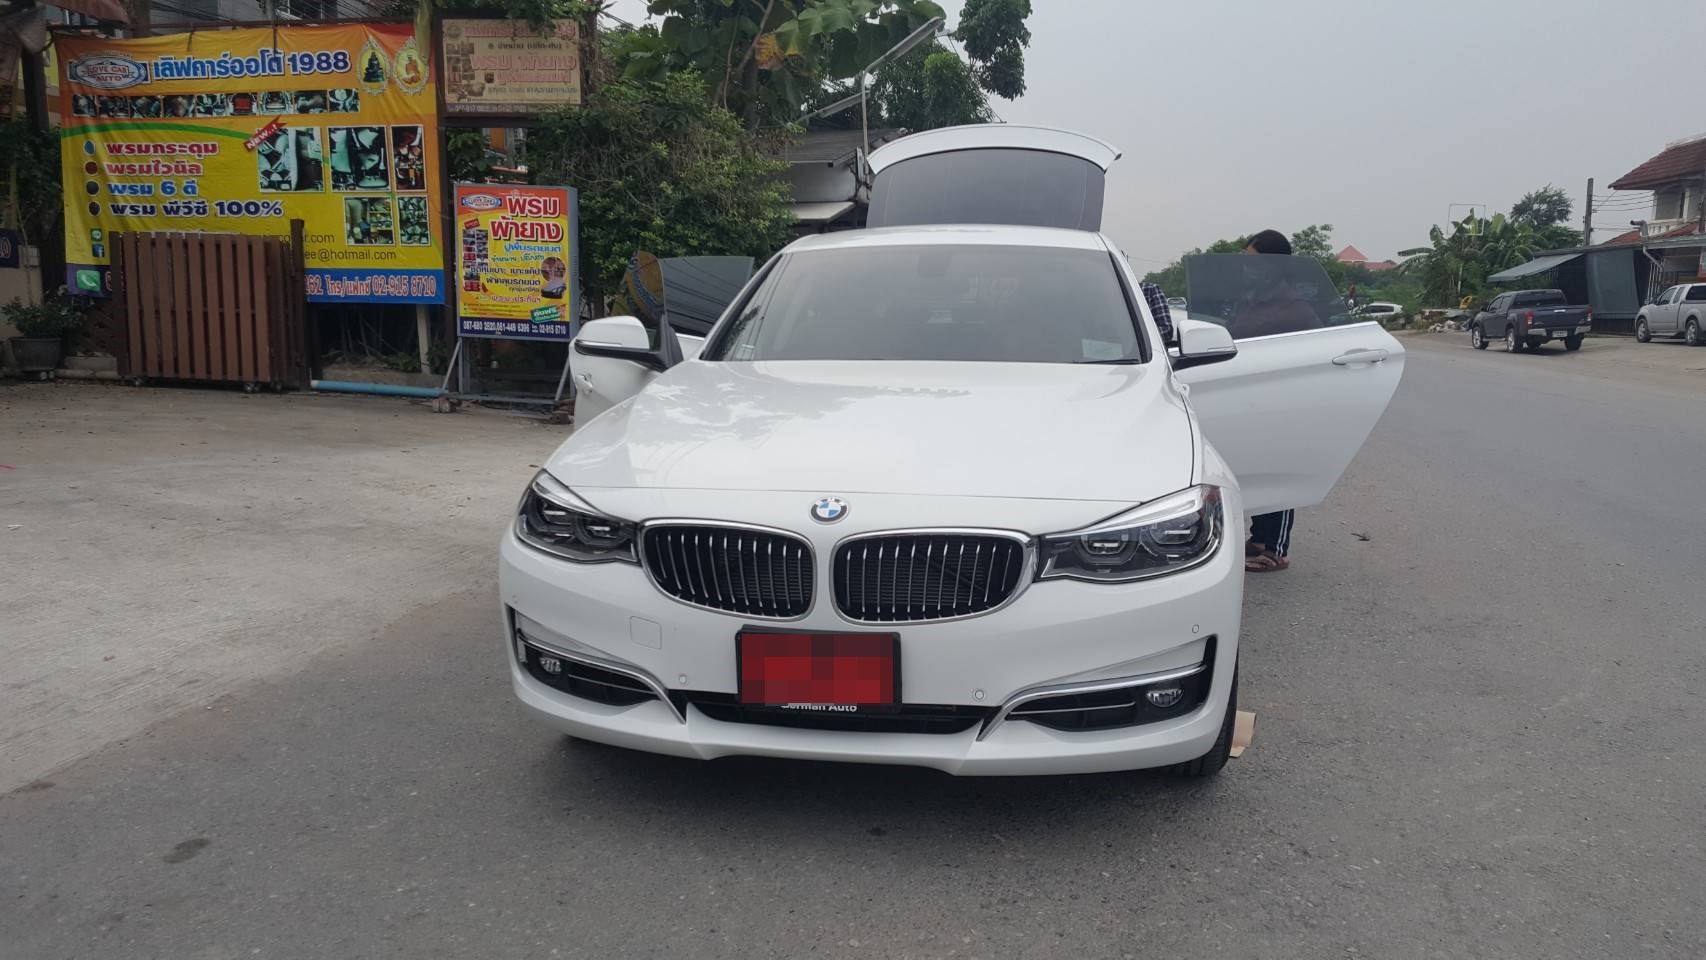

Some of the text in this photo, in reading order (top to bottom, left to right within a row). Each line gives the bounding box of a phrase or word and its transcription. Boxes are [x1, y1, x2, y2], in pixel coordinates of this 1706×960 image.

[88, 65, 128, 74] LOVE CAR
[287, 51, 351, 75] 1988
[106, 142, 219, 159] พรมกระดุม
[105, 159, 203, 176] พรมไวนิล
[108, 179, 198, 196] พรม 6 ดี
[110, 201, 284, 217] พรม พีวีซี 100%
[507, 196, 560, 218] พรม
[490, 215, 562, 241] ผ้ายาง
[303, 249, 397, 262] ee@hotmail.com
[372, 275, 409, 296] 02-915
[410, 275, 436, 297] 8710
